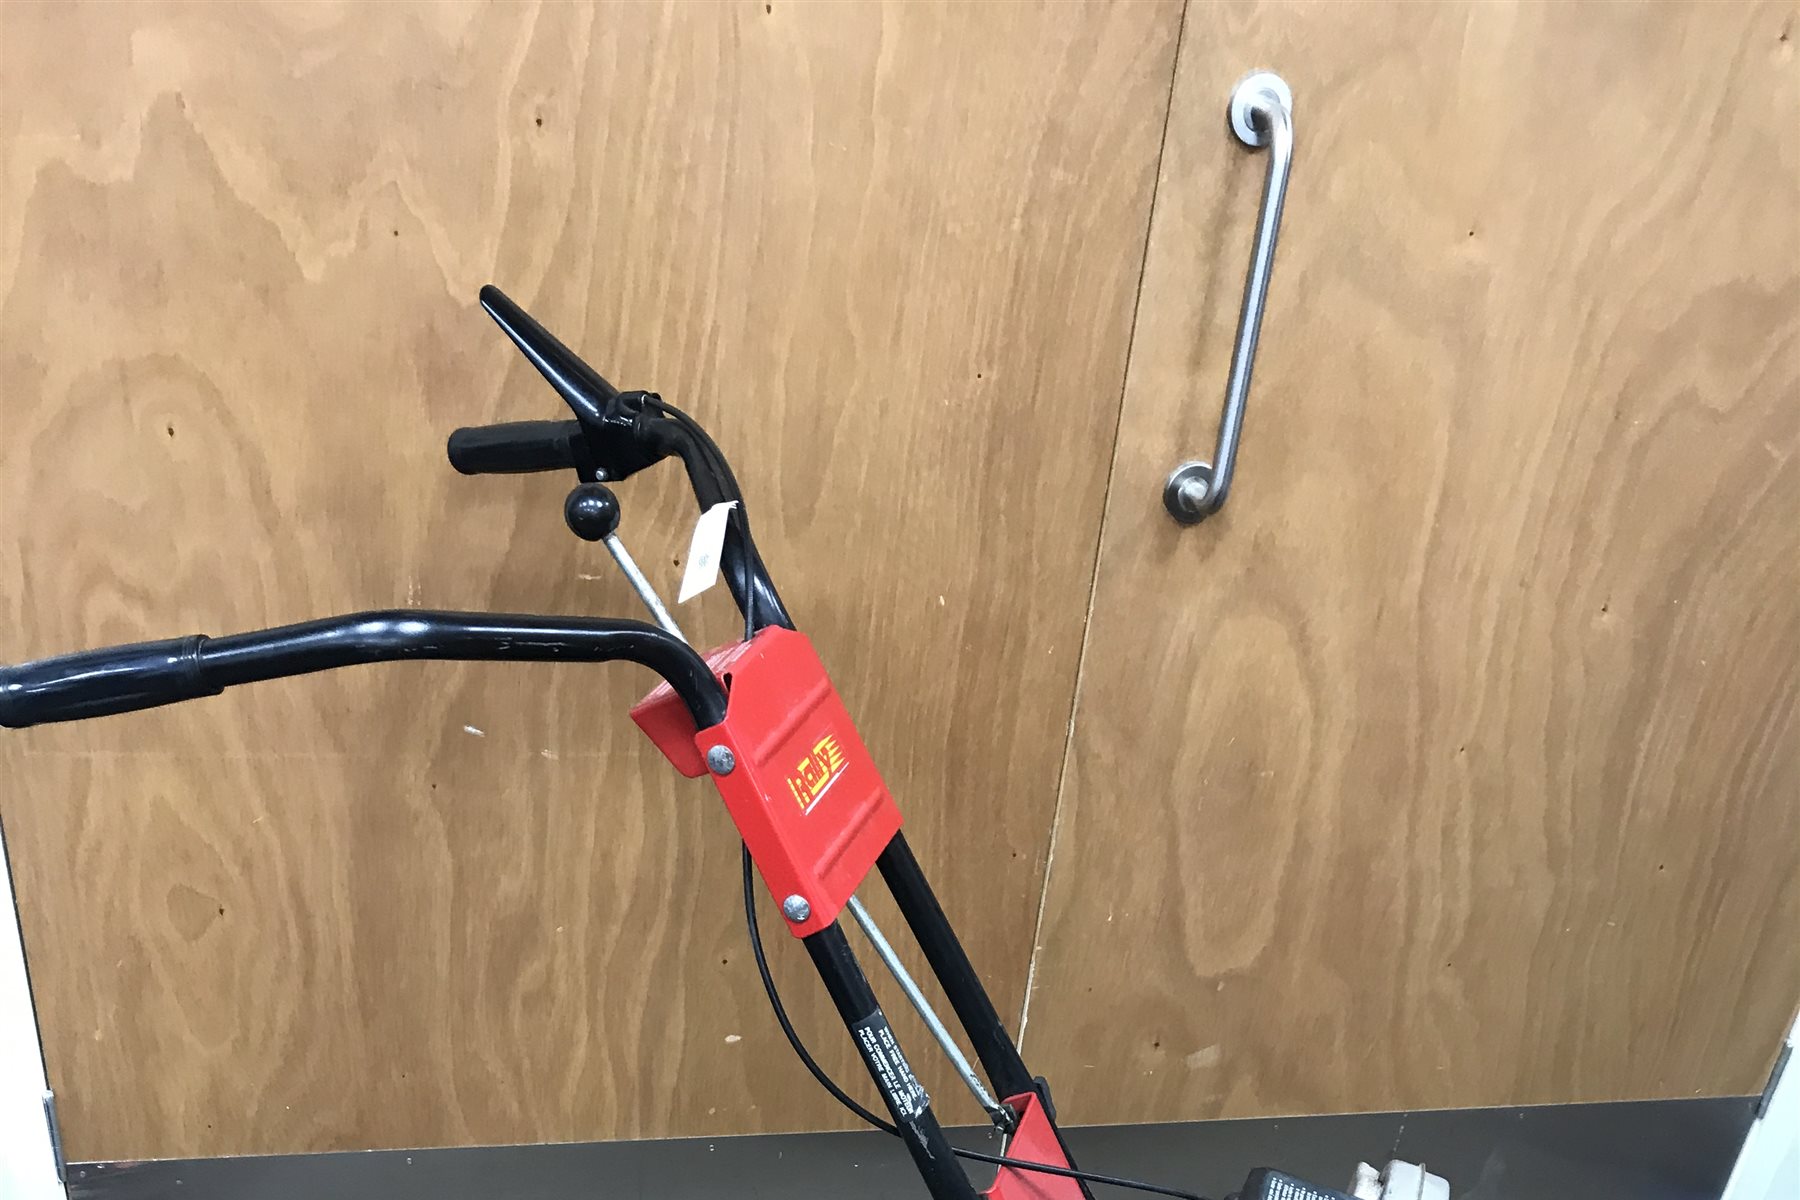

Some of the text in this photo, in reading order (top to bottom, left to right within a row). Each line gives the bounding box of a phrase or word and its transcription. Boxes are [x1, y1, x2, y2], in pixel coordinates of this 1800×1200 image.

[858, 1029, 874, 1053] PLACER
[871, 1052, 885, 1072] VOTRE
[881, 1073, 893, 1089] MAIN
[878, 1029, 891, 1049] PLACE
[889, 1049, 900, 1066] FREE
[898, 1065, 909, 1083] HAND
[884, 1026, 895, 1045] WHEN
[864, 1026, 914, 1114] POUR COMMENCER LE MOTEUR
